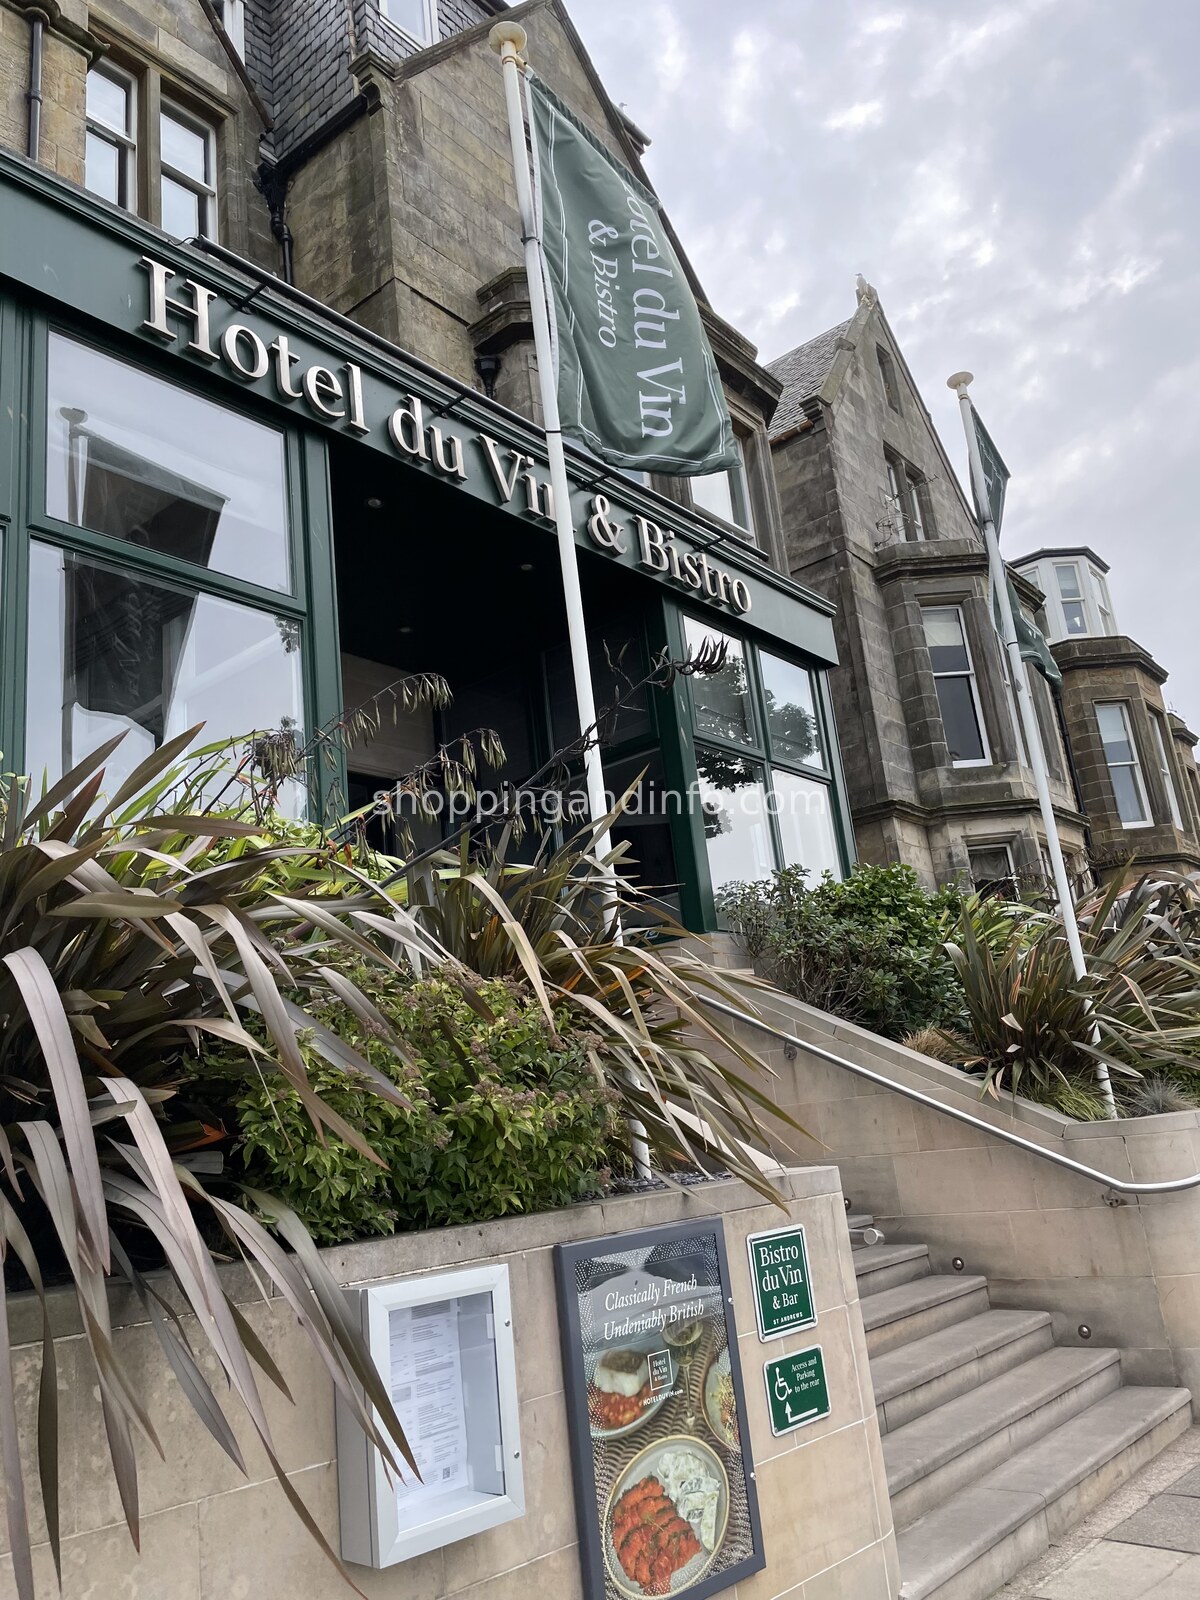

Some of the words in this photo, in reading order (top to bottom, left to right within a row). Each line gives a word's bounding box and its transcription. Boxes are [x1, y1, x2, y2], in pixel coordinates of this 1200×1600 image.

[588, 219, 619, 247] &
[626, 195, 673, 278] otel
[589, 250, 620, 348] Bistro
[633, 288, 680, 350] du
[636, 357, 686, 439] Vin
[140, 255, 370, 436] Hotel
[388, 393, 468, 483] du
[587, 494, 627, 555] &
[632, 513, 752, 615] Bistro
[759, 1244, 798, 1267] Bistro
[605, 1283, 660, 1311] Classically
[663, 1273, 697, 1298] French
[762, 1270, 780, 1292] du
[778, 1265, 803, 1287] Vin
[772, 1295, 781, 1310] &
[782, 1292, 798, 1307] Bar
[604, 1308, 666, 1340] Undeniably
[669, 1299, 704, 1324] British
[780, 1311, 803, 1323] ANDREWS
[791, 1361, 807, 1372] Access
[808, 1356, 817, 1366] and
[796, 1369, 816, 1381] Parking
[795, 1385, 800, 1393] to
[800, 1382, 809, 1390] the
[810, 1378, 820, 1387] rear
